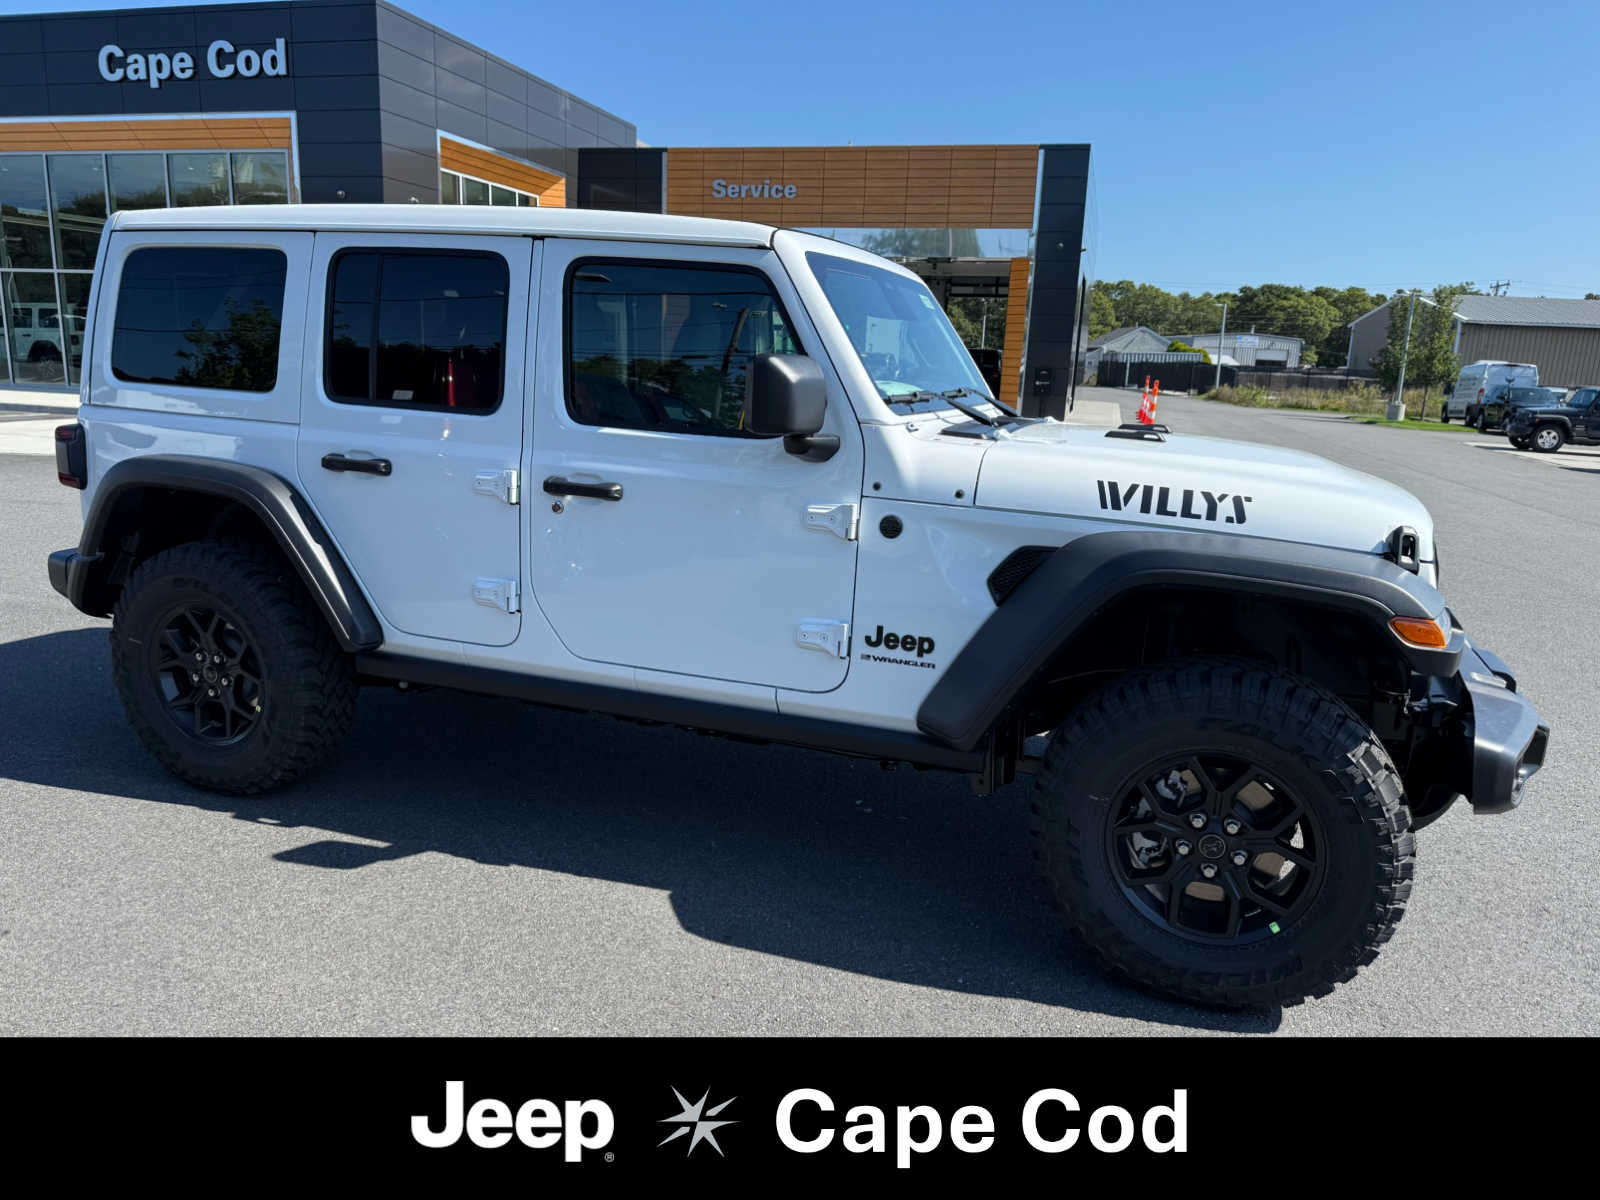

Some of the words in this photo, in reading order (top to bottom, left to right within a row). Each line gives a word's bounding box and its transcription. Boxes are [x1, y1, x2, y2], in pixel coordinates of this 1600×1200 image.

[98, 44, 194, 89] Cape
[207, 38, 288, 79] Cod
[712, 179, 798, 200] Service
[1096, 479, 1253, 525] WILLYS
[865, 625, 935, 658] Jeep
[872, 655, 937, 670] WRANGLER
